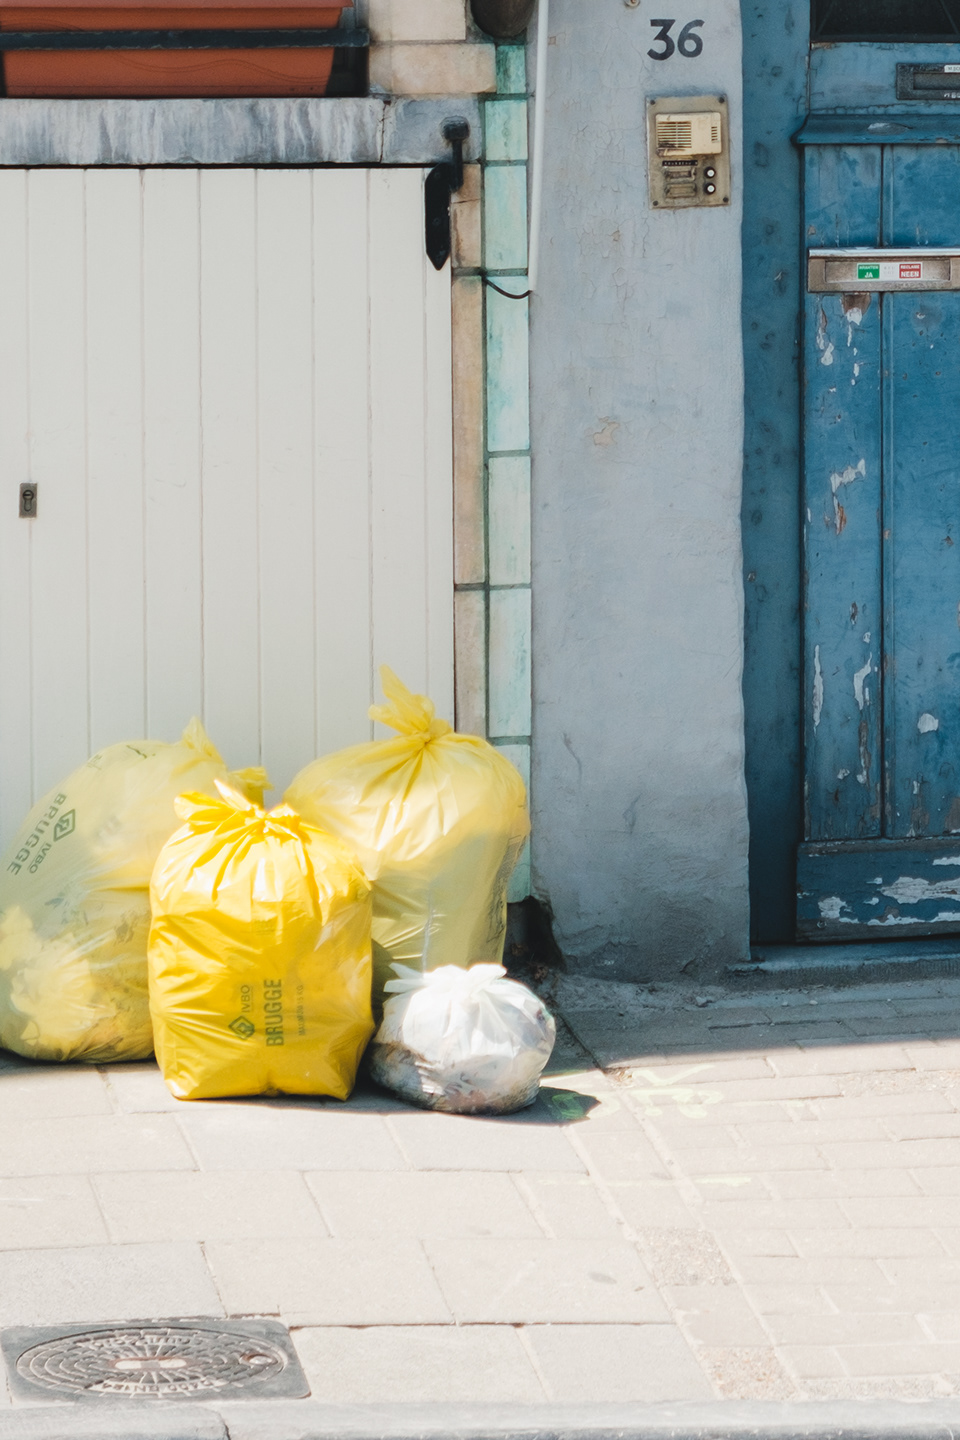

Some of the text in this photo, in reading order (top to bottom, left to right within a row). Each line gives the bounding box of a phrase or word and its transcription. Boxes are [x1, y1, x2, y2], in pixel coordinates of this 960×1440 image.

[647, 19, 705, 61] 36
[6, 793, 67, 875] BRUGGE
[28, 841, 52, 874] IVBO
[241, 984, 250, 1013] IVBO
[263, 979, 284, 1047] BRUGGE
